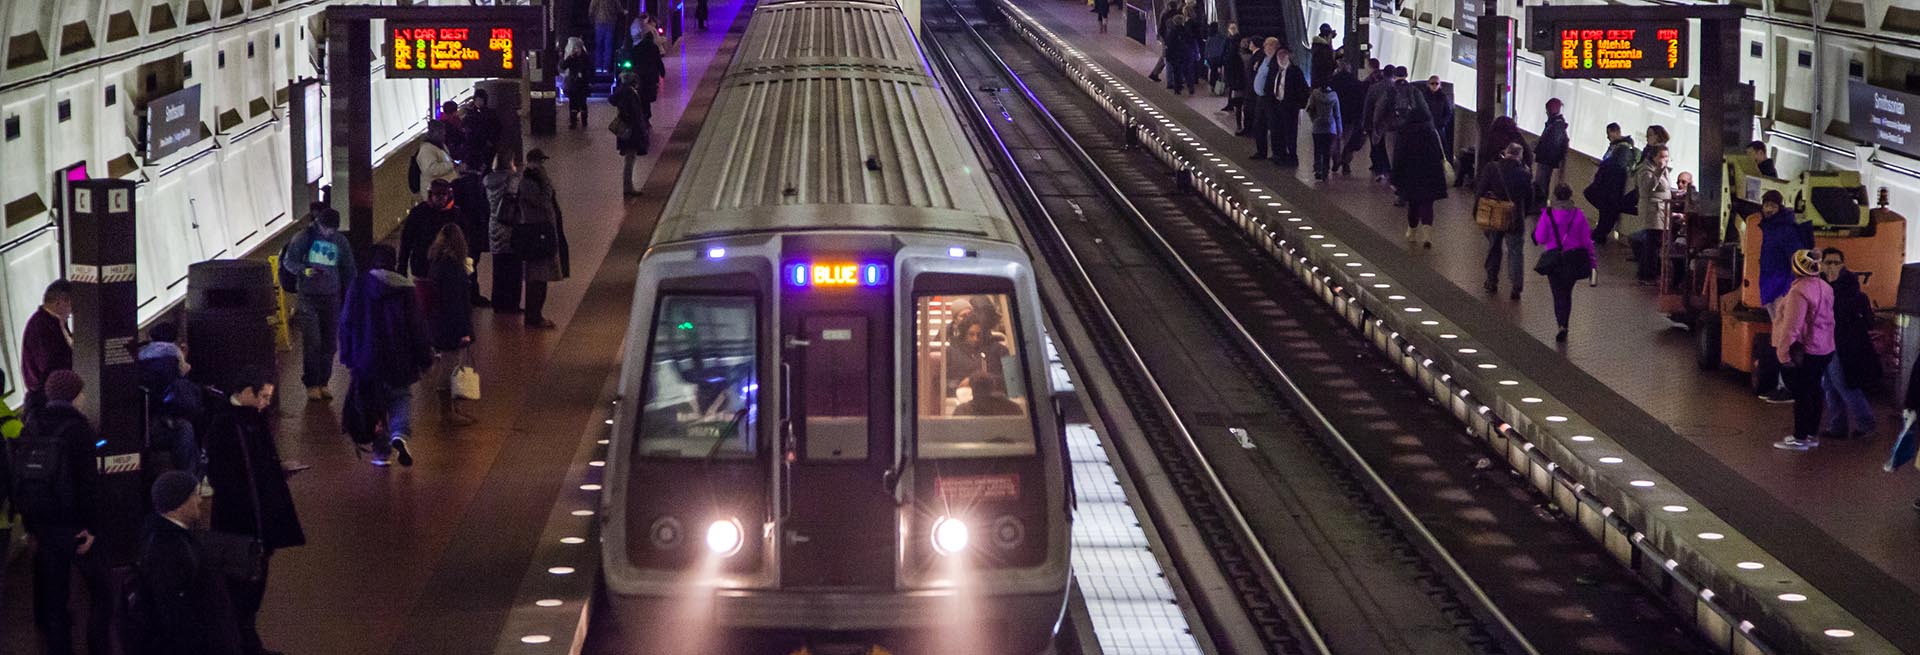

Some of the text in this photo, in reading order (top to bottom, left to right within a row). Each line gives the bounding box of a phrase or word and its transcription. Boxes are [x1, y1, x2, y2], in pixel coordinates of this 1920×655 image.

[414, 28, 437, 40] CAR
[440, 28, 469, 40] DEST
[491, 28, 513, 39] MIN
[1562, 29, 1678, 40] LN CAR DEST MIN
[395, 39, 412, 49] BL
[416, 39, 426, 49] 8
[489, 38, 513, 50] BRD
[1562, 39, 1678, 50] SV 6 Wiehle 2
[395, 49, 412, 60] OR
[416, 49, 426, 59] 6
[503, 49, 513, 59] 3
[1562, 49, 1678, 59] BL 6 Frnconia 3
[395, 59, 412, 69] BL
[416, 59, 426, 69] 8
[502, 59, 513, 69] 6
[1562, 58, 1678, 69] OR 8 Vienna 7
[812, 264, 858, 284] BLUE
